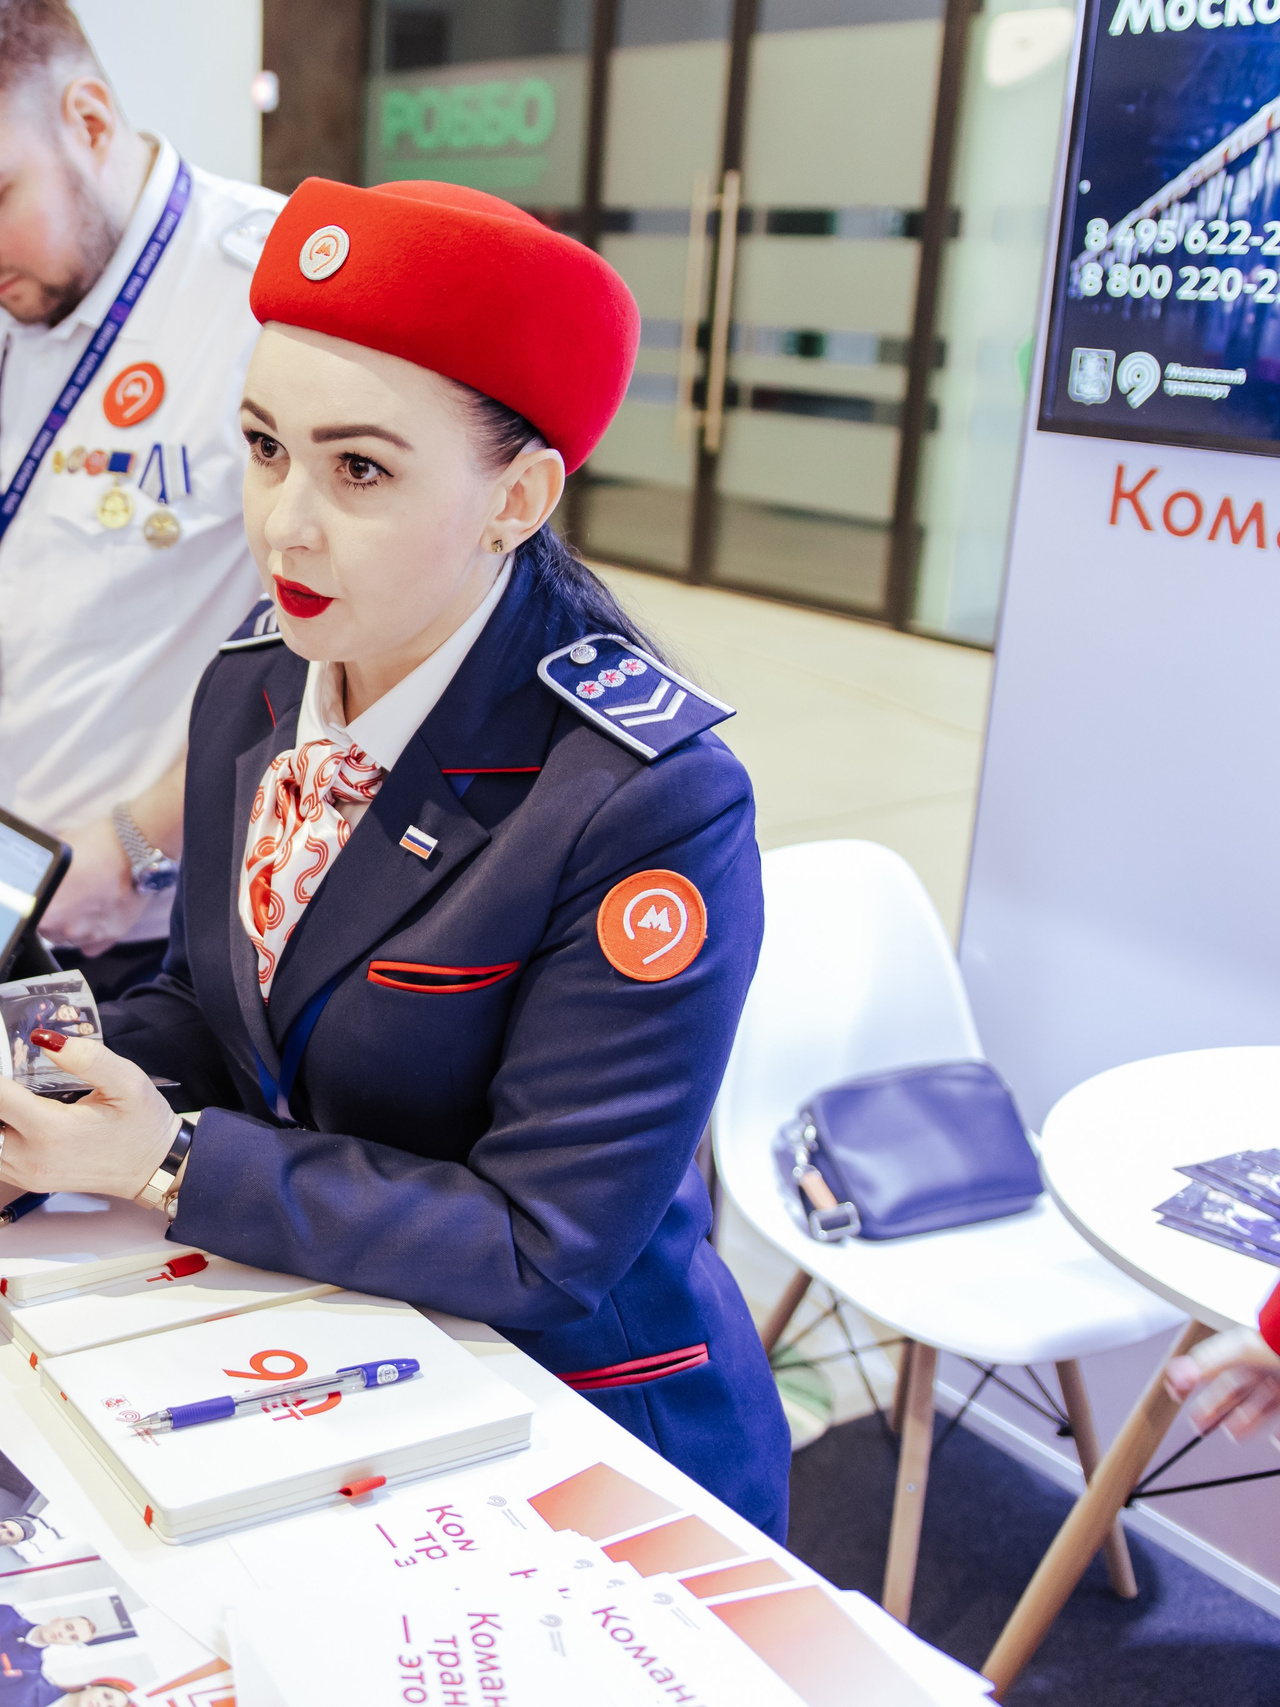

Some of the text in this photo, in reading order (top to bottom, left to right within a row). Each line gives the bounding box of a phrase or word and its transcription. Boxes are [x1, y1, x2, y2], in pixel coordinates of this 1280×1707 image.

[1085, 218, 1280, 256] 8 495 622-2
[1080, 262, 1280, 303] 8 800 220-2
[1109, 463, 1280, 550] Ком
[414, 1531, 448, 1560] тр
[398, 1655, 427, 1704] это
[426, 1635, 468, 1707] тран
[466, 1612, 508, 1707] Коман
[591, 1606, 707, 1707] Коман
